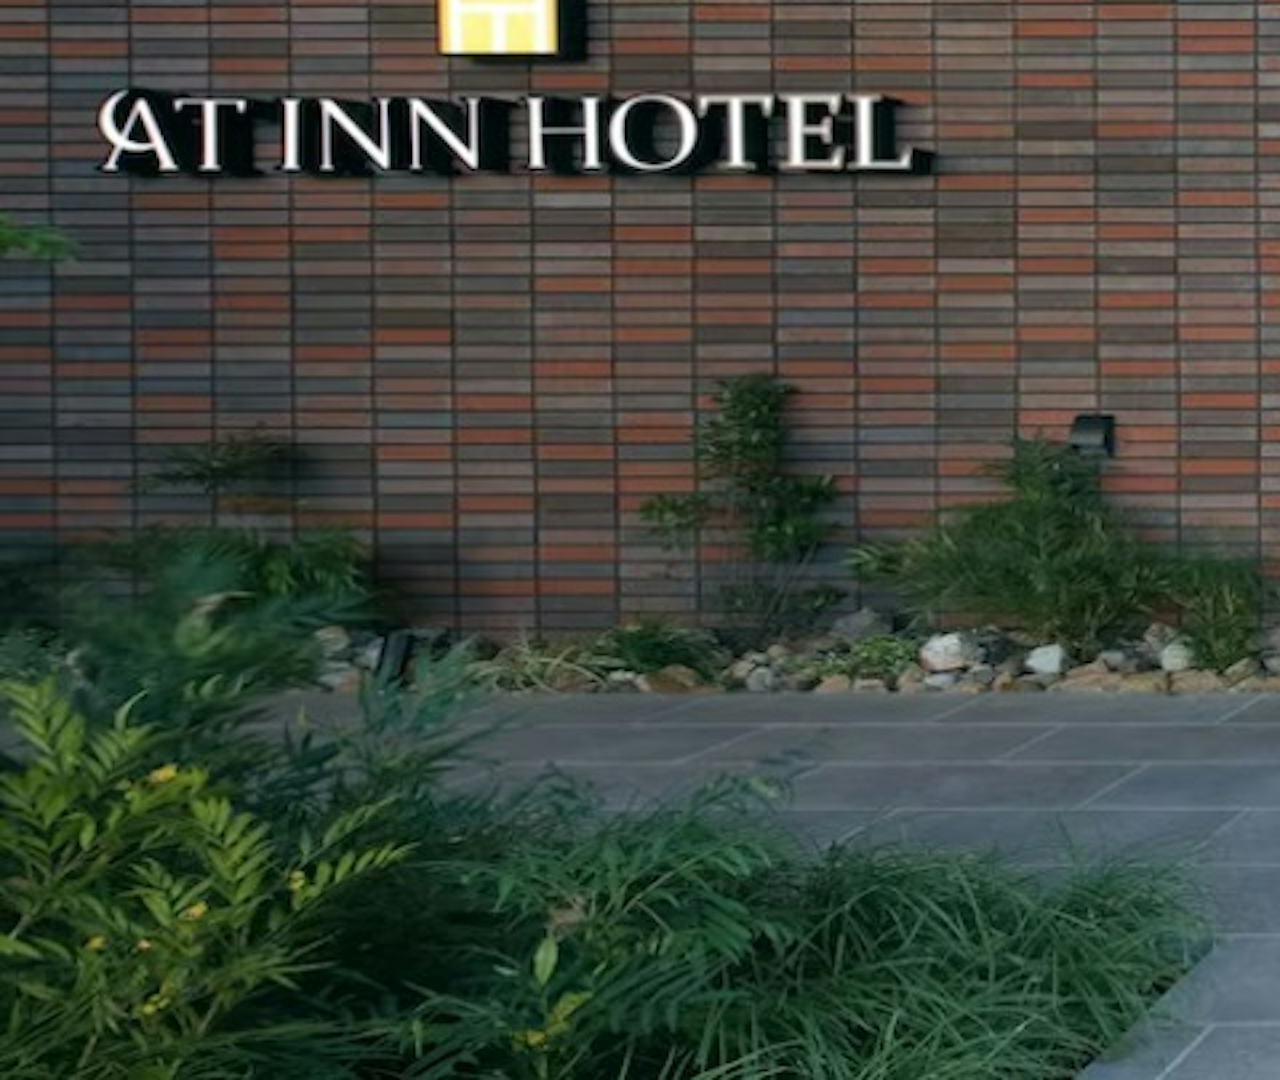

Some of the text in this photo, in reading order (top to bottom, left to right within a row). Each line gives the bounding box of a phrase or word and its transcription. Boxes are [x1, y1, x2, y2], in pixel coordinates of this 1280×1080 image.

[98, 89, 913, 172] AT INN HOTEL
